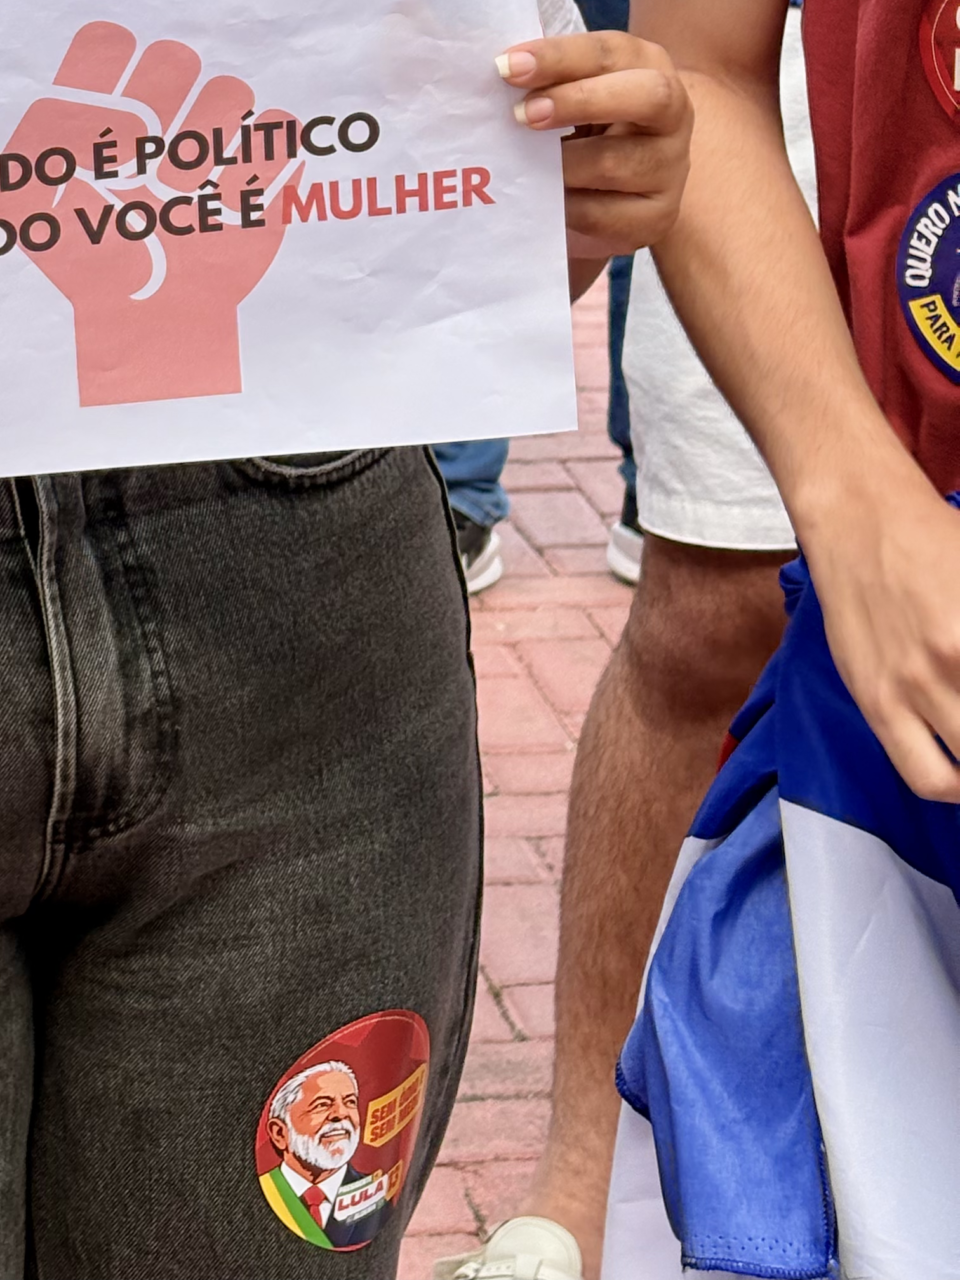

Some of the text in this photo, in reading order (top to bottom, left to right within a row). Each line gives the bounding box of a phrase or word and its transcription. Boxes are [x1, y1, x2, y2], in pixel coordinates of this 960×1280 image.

[93, 128, 119, 181] É
[135, 110, 380, 176] POLÍTICO
[74, 181, 223, 245] VOCÊ
[240, 174, 266, 229] É
[281, 167, 495, 225] MULHER
[904, 202, 951, 288] QUERO
[919, 300, 957, 352] PARA
[337, 1179, 384, 1212] LULA
